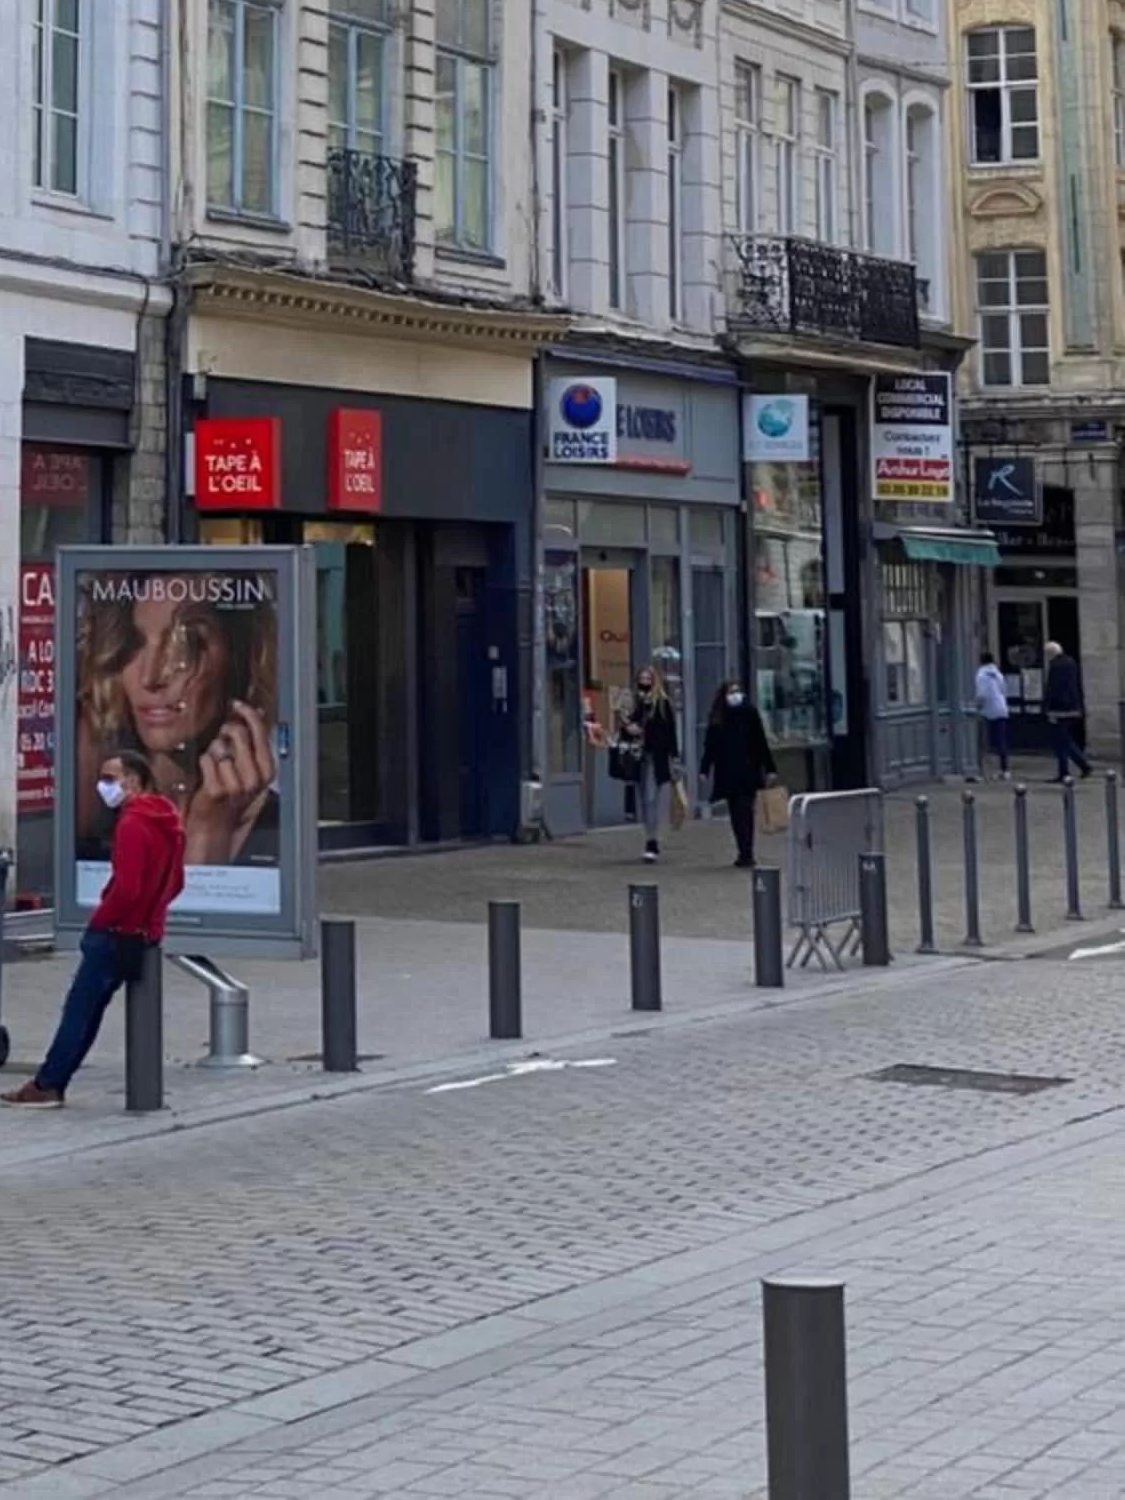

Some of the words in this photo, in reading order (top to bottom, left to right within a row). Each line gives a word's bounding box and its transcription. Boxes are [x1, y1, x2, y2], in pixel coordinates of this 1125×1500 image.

[553, 431, 610, 445] FRANCE
[204, 454, 247, 473] TAPE
[250, 449, 263, 472] À
[553, 446, 610, 459] LOISIRS
[208, 473, 263, 493] L'OEIL
[22, 571, 55, 607] CA
[91, 577, 264, 602] MAUBOUSSIN
